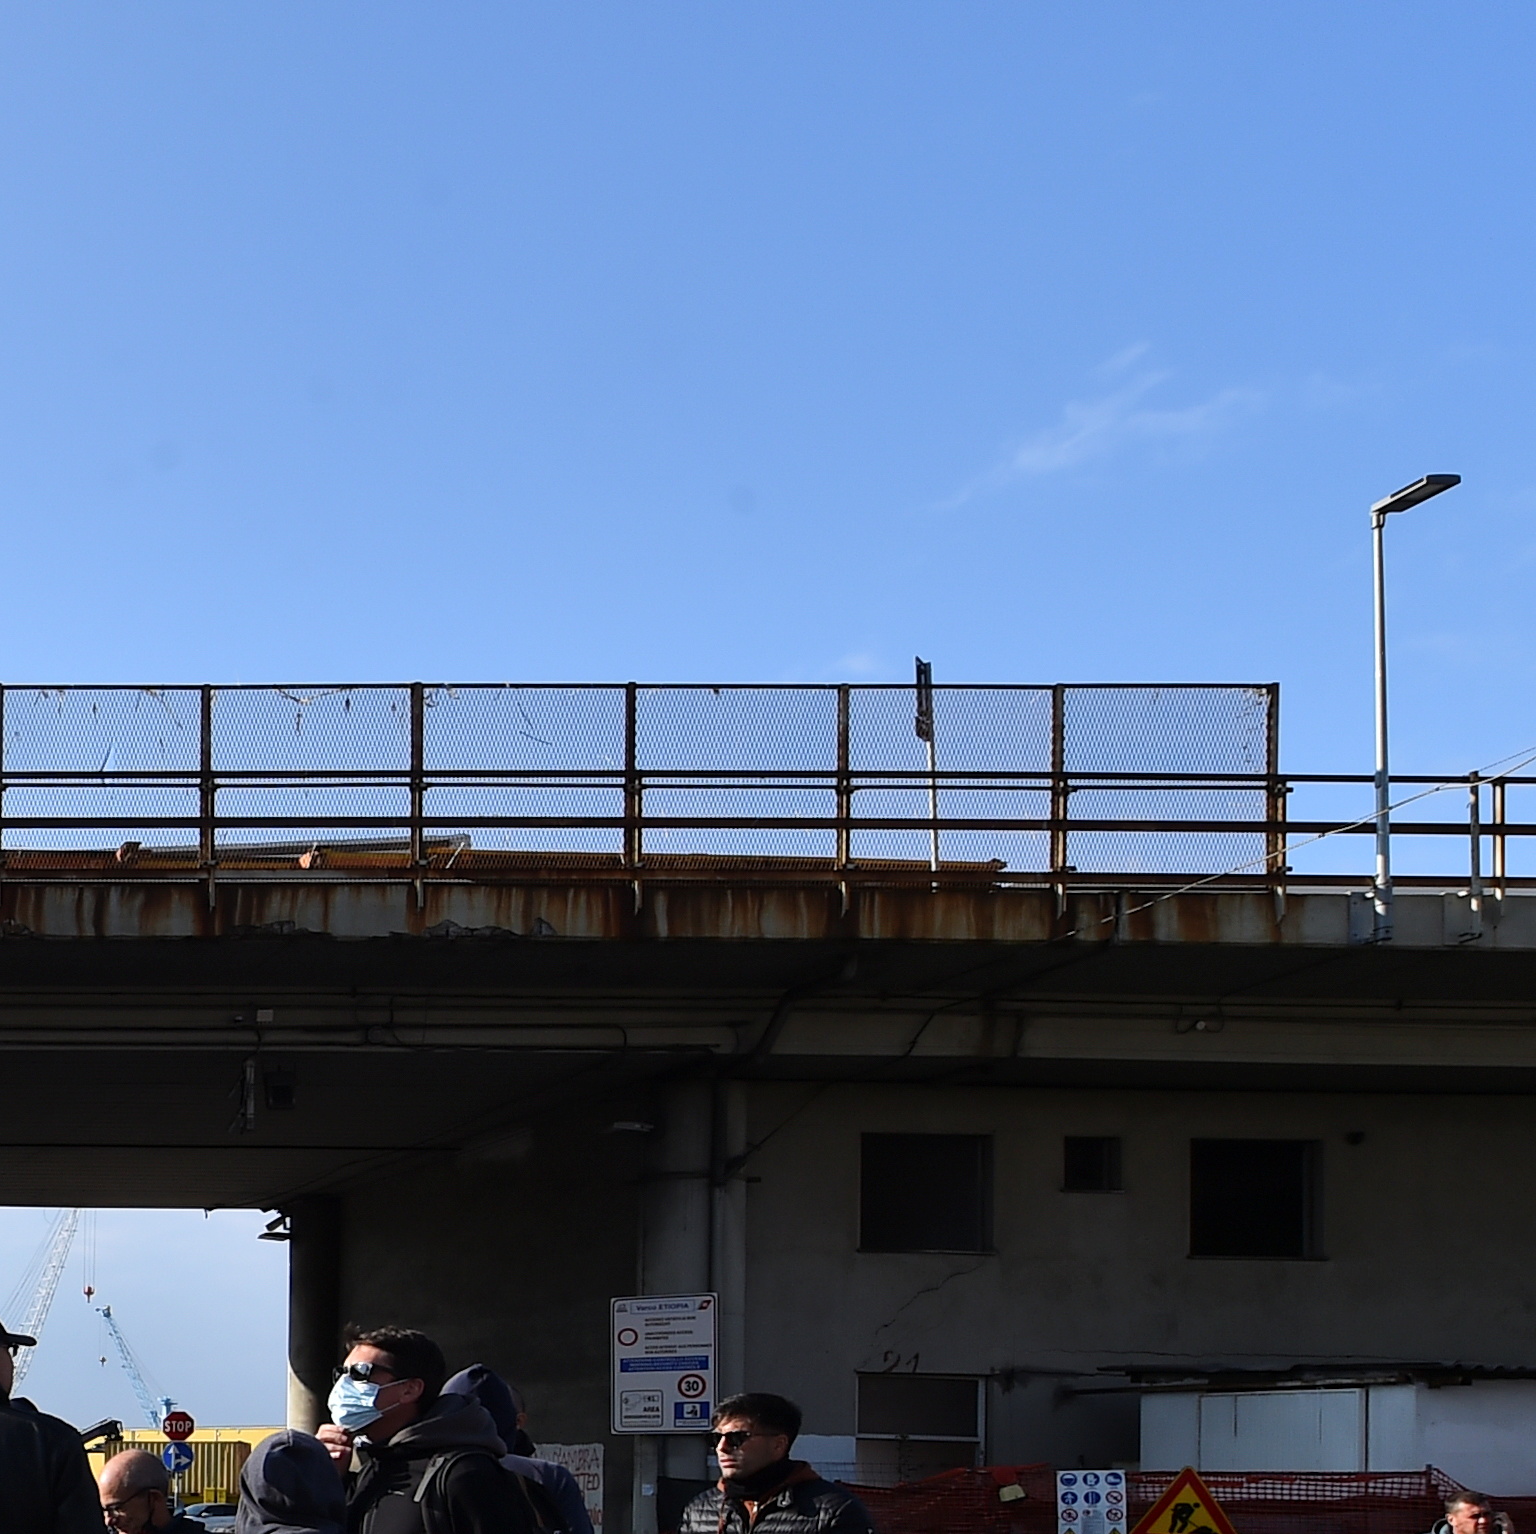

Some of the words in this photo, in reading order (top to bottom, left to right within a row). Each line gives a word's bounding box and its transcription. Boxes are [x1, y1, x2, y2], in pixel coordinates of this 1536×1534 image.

[658, 1302, 690, 1311] ETIOPIA
[684, 1380, 700, 1392] 30
[164, 1420, 193, 1433] STOP
